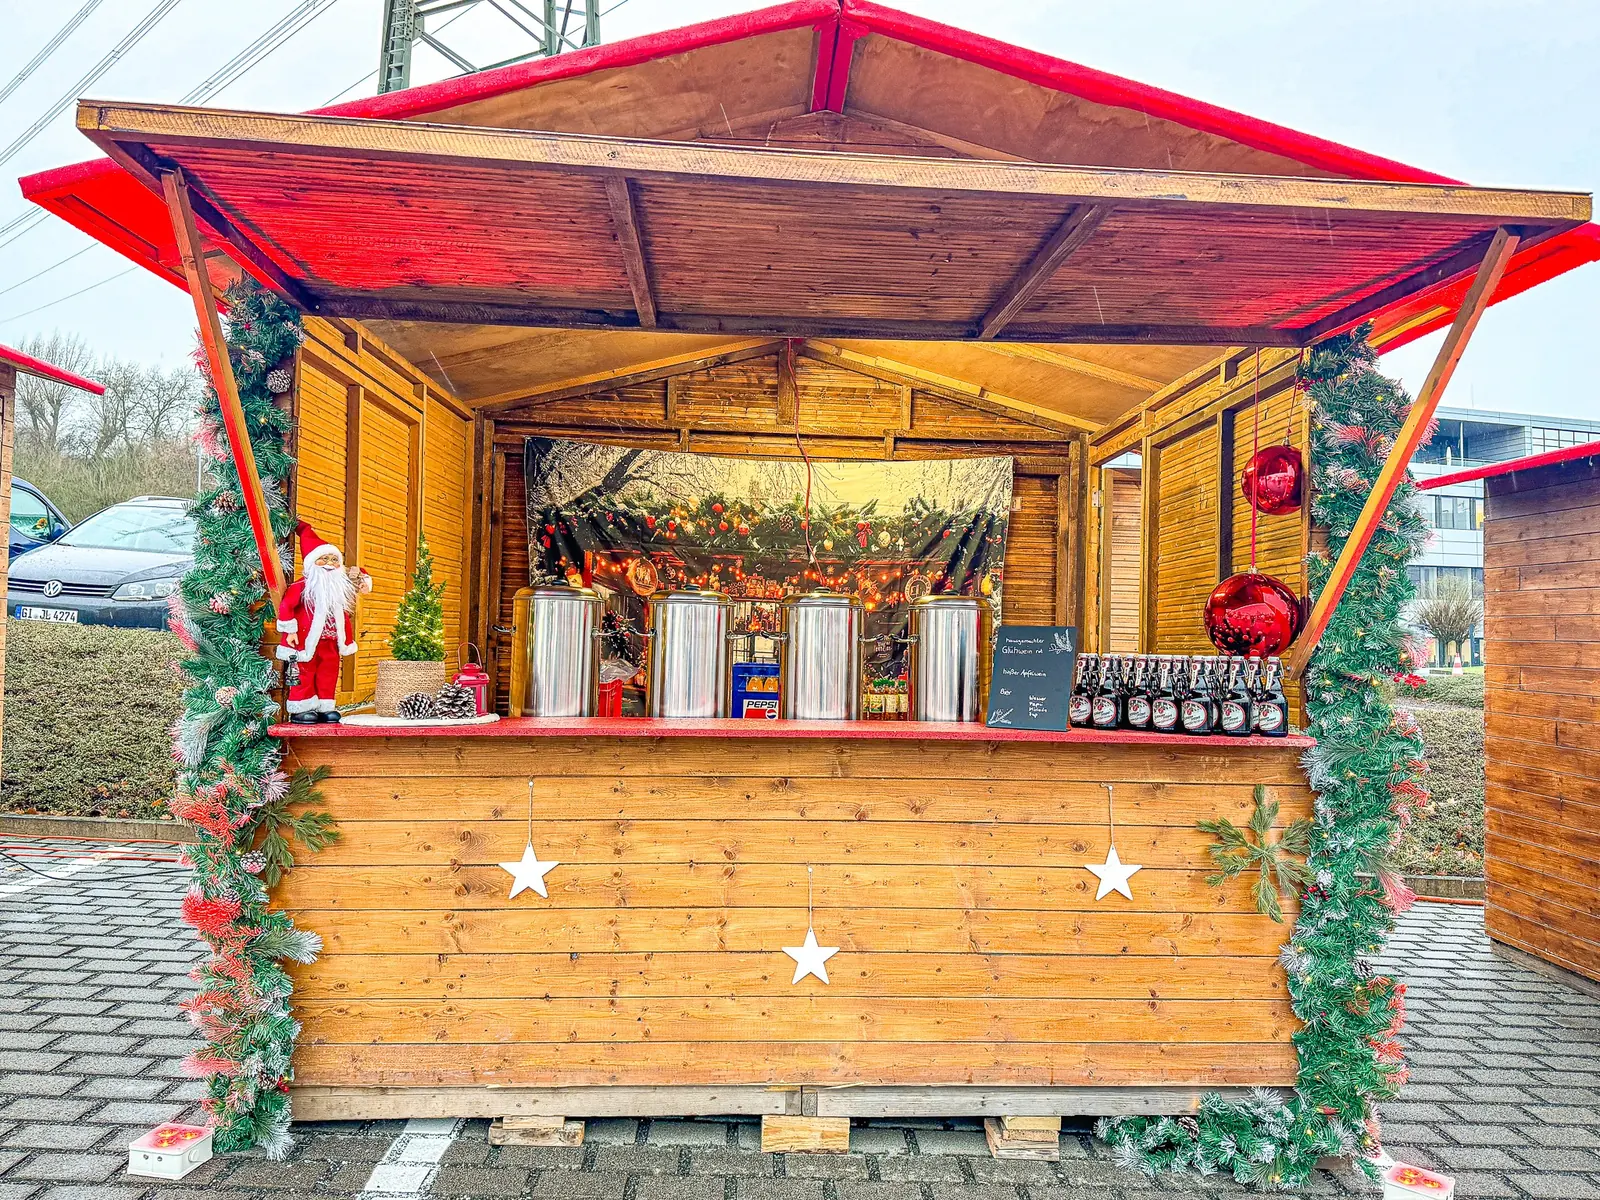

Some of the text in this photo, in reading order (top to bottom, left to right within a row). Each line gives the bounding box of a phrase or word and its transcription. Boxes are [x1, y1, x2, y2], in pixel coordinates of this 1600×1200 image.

[22, 608, 76, 622] GI JL 4274
[1002, 646, 1032, 654] Glühwein
[746, 700, 778, 708] PEPSI
